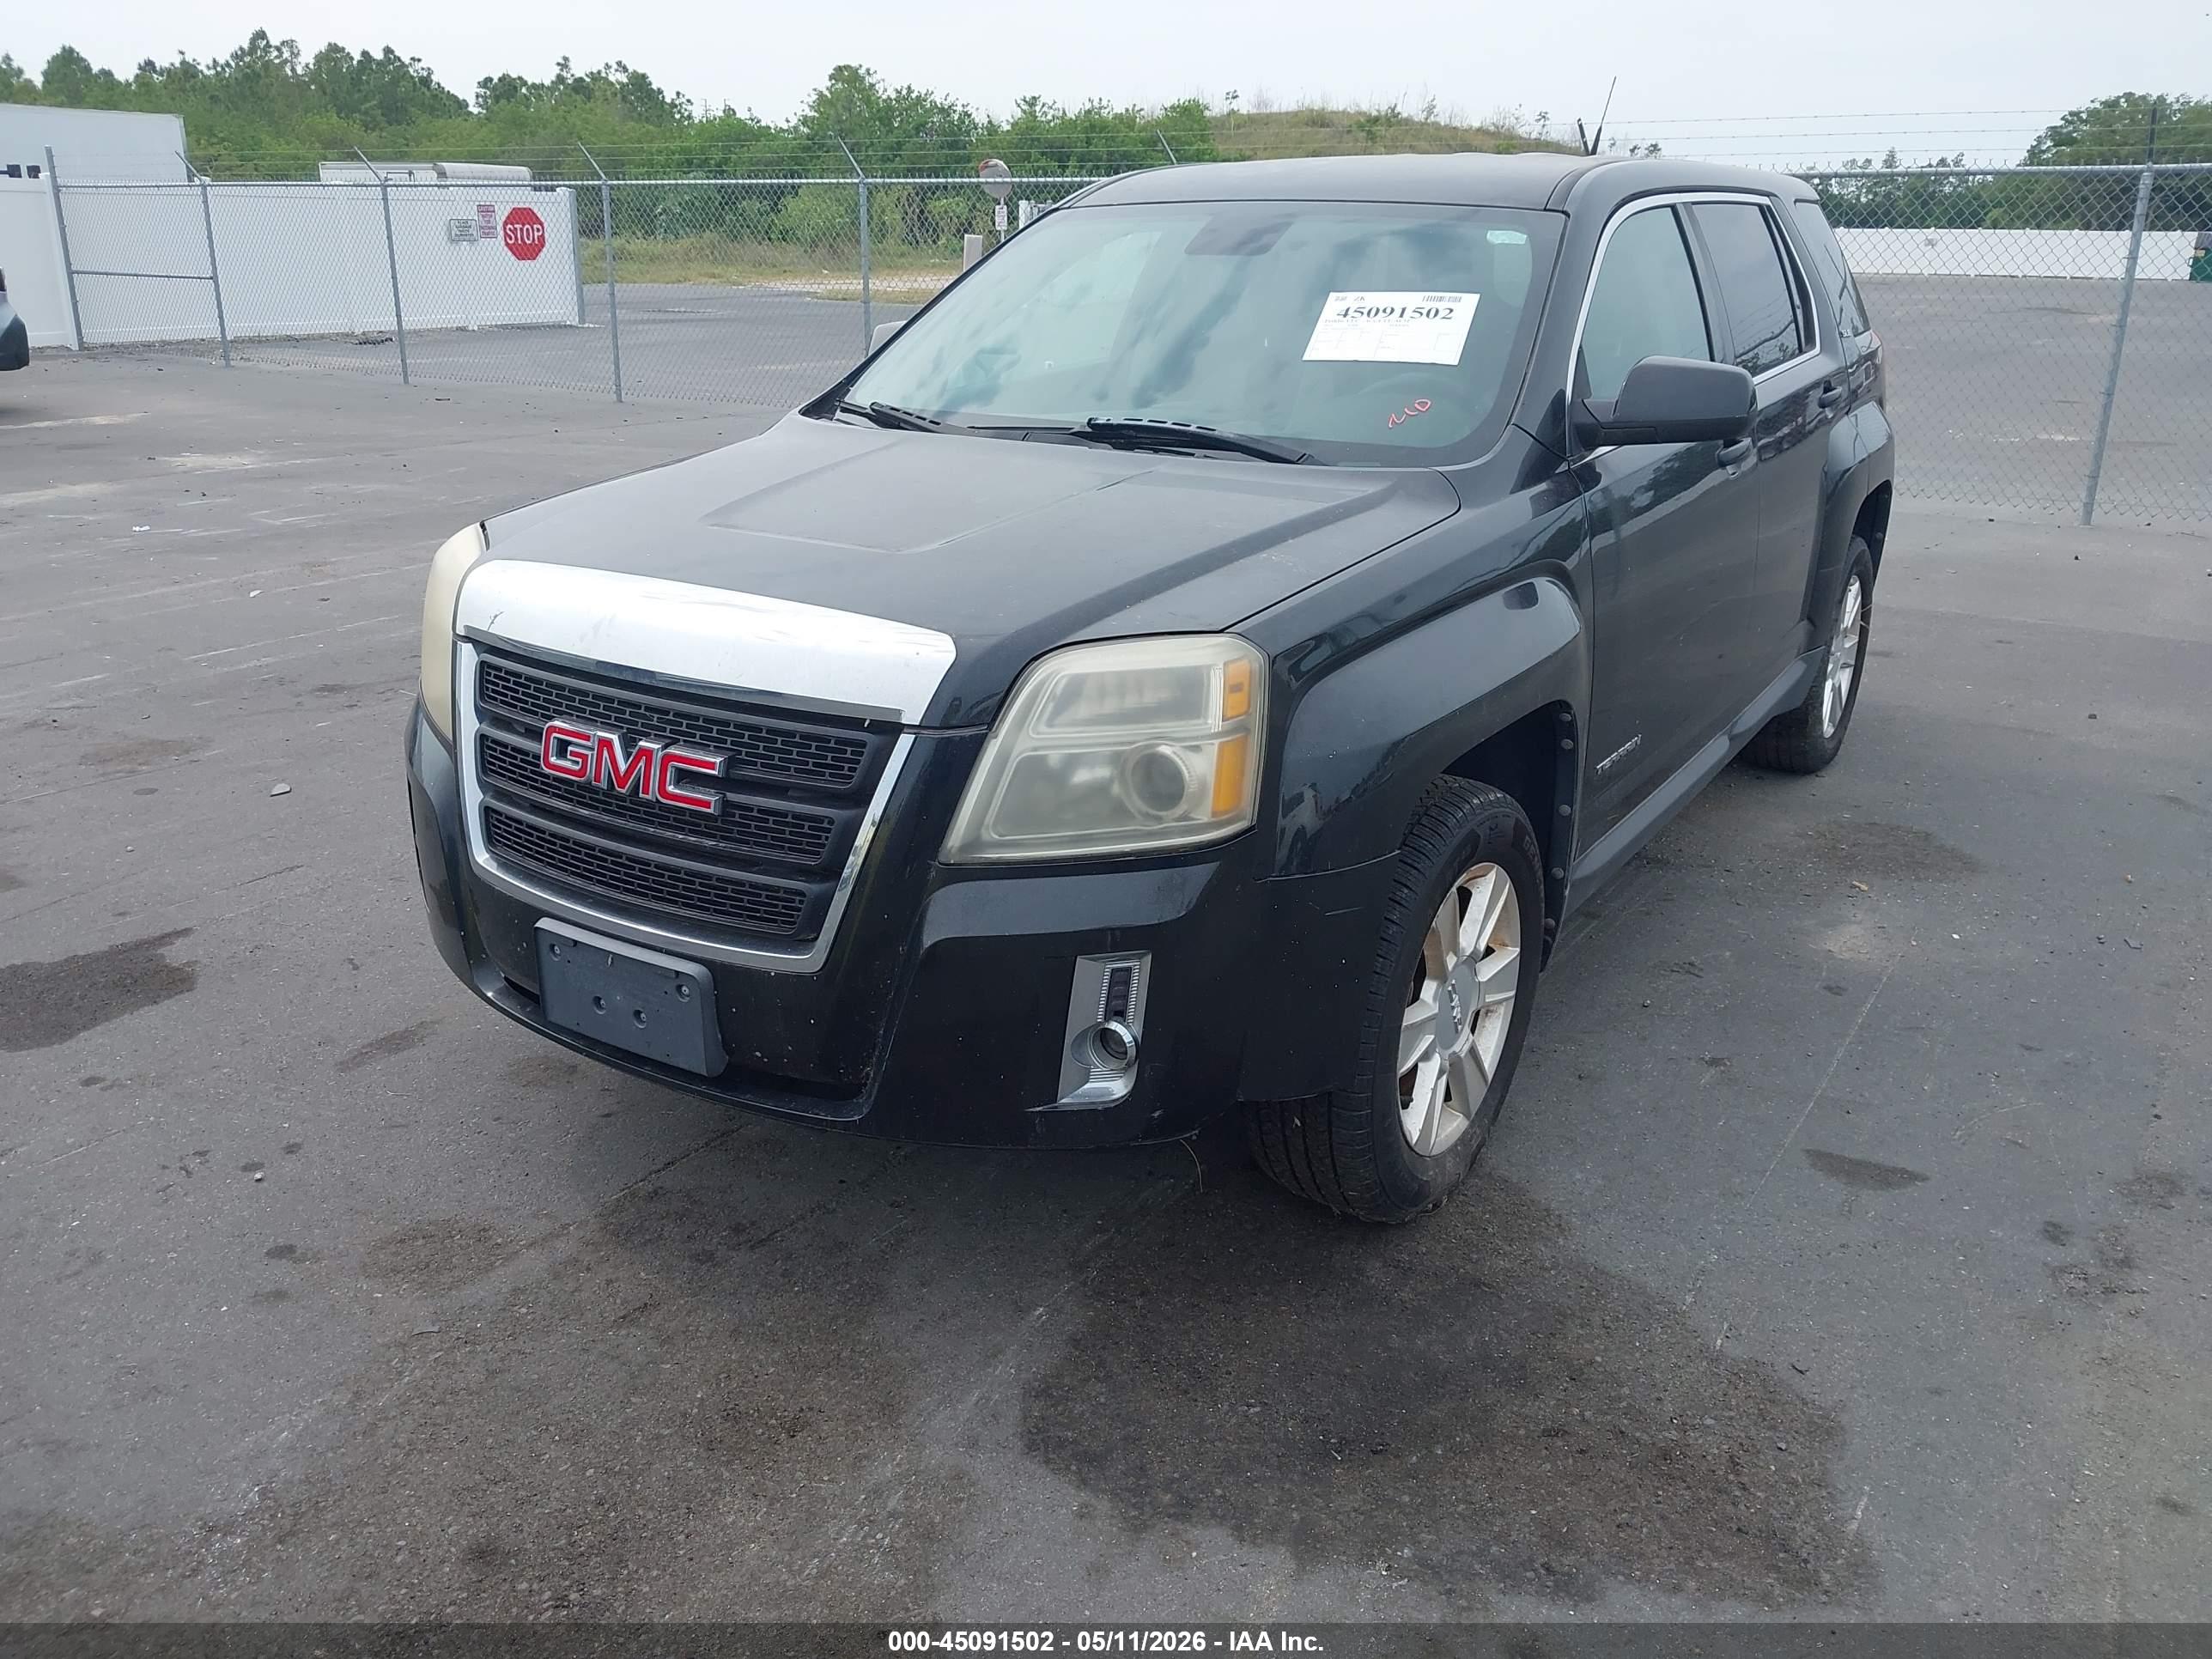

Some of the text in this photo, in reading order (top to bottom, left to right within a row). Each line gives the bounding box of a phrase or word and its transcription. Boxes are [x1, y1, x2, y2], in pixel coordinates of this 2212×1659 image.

[506, 224, 543, 244] STOP
[1336, 306, 1454, 319] 45091502
[541, 720, 726, 816] GMC
